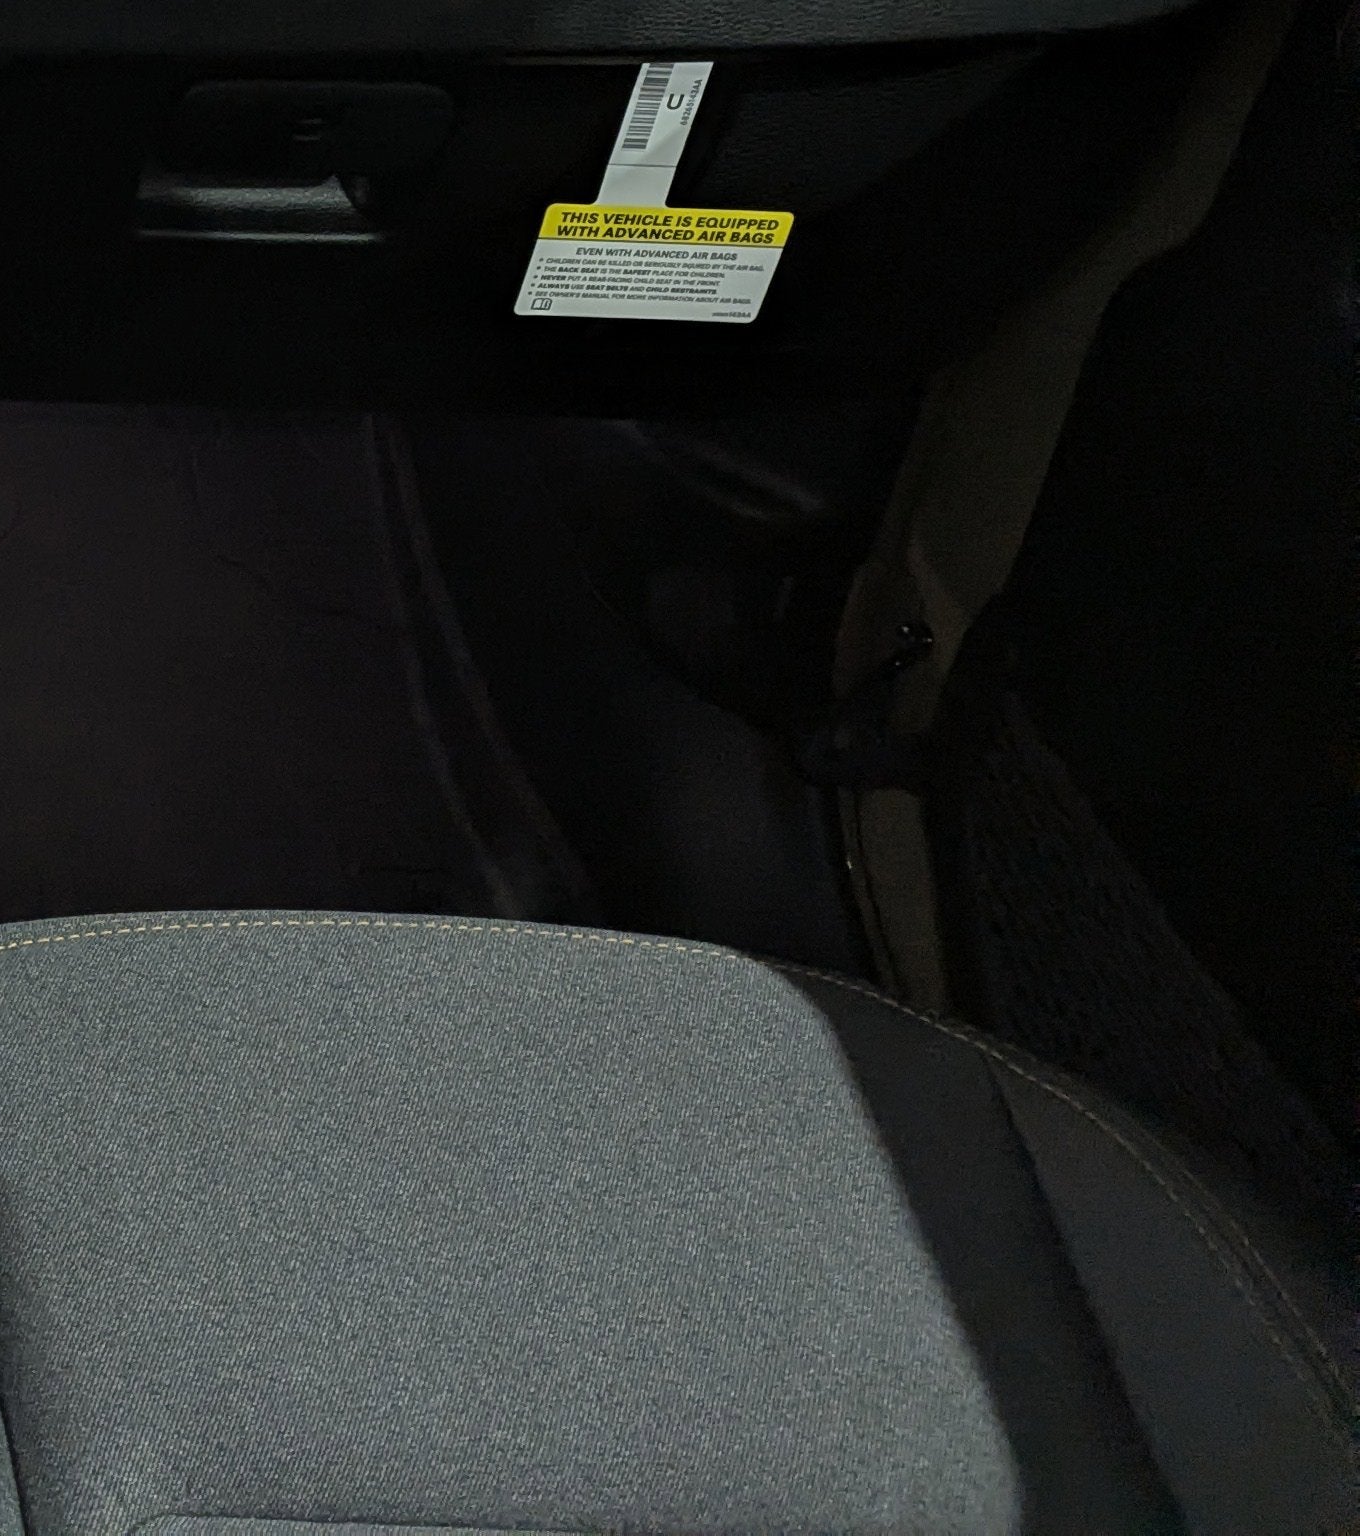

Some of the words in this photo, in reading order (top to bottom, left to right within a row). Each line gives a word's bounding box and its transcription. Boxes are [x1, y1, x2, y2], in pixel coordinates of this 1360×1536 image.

[666, 93, 685, 110] U
[561, 211, 600, 224] THIS
[603, 213, 674, 227] VEHICLE
[675, 216, 693, 227] IS
[695, 217, 780, 231] EQUIPPED
[557, 225, 600, 238] WITH
[601, 227, 695, 241] ADVANCED
[697, 230, 727, 242] AIR
[729, 232, 775, 244] BAGS
[576, 247, 603, 256] EVEN
[605, 248, 632, 257] WITH
[633, 249, 689, 260] ADVANCED
[690, 252, 709, 260] AIR
[710, 252, 738, 261] BAGS
